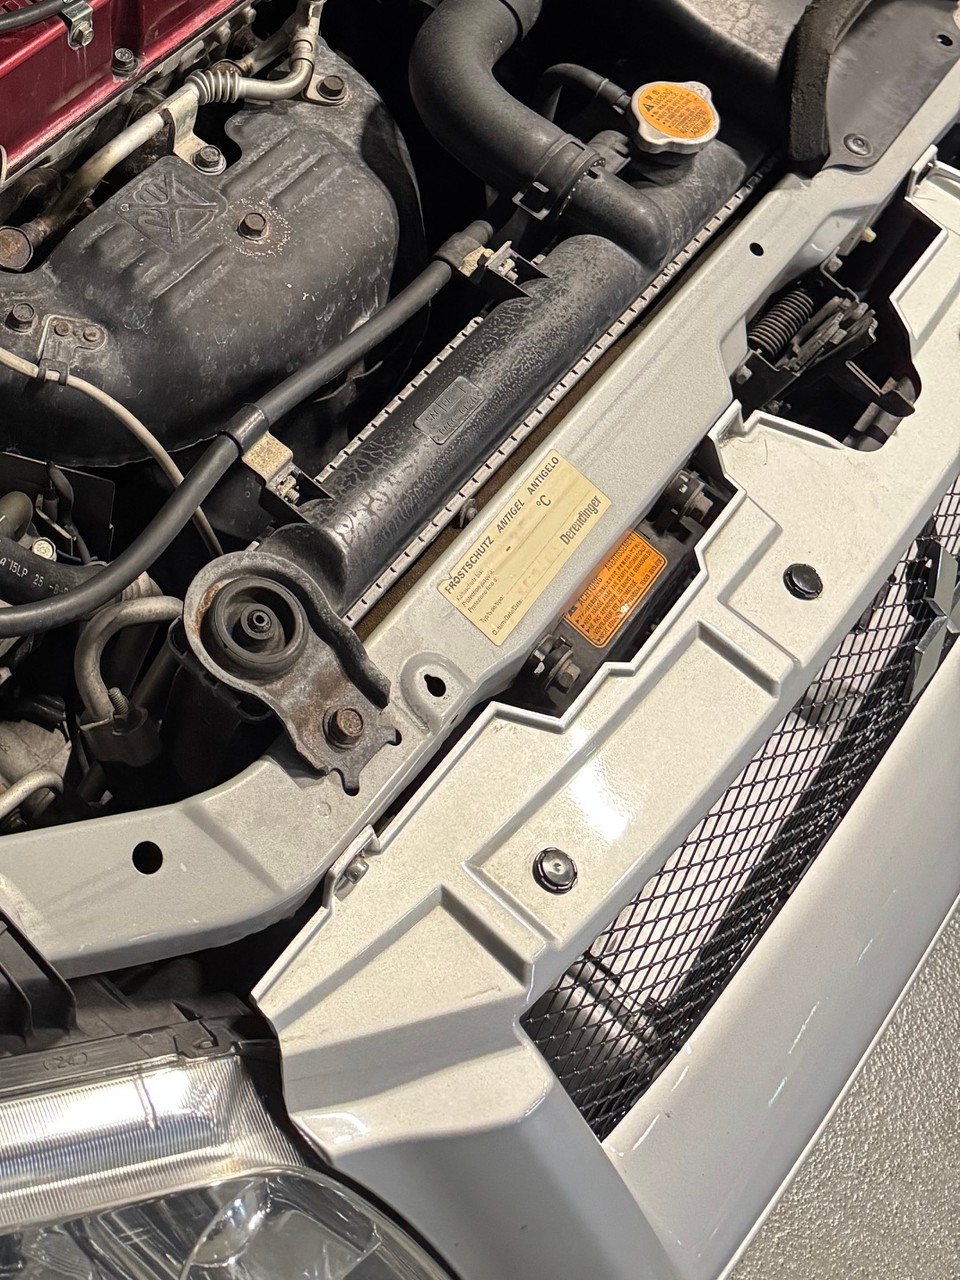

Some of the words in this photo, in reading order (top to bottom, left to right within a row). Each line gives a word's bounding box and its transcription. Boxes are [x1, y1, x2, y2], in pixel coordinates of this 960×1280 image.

[527, 456, 560, 495] ANTIGELO
[497, 499, 525, 534] ANTIGEL
[559, 495, 602, 545] Derendinger
[444, 536, 494, 594] FROSTSCHUTZ
